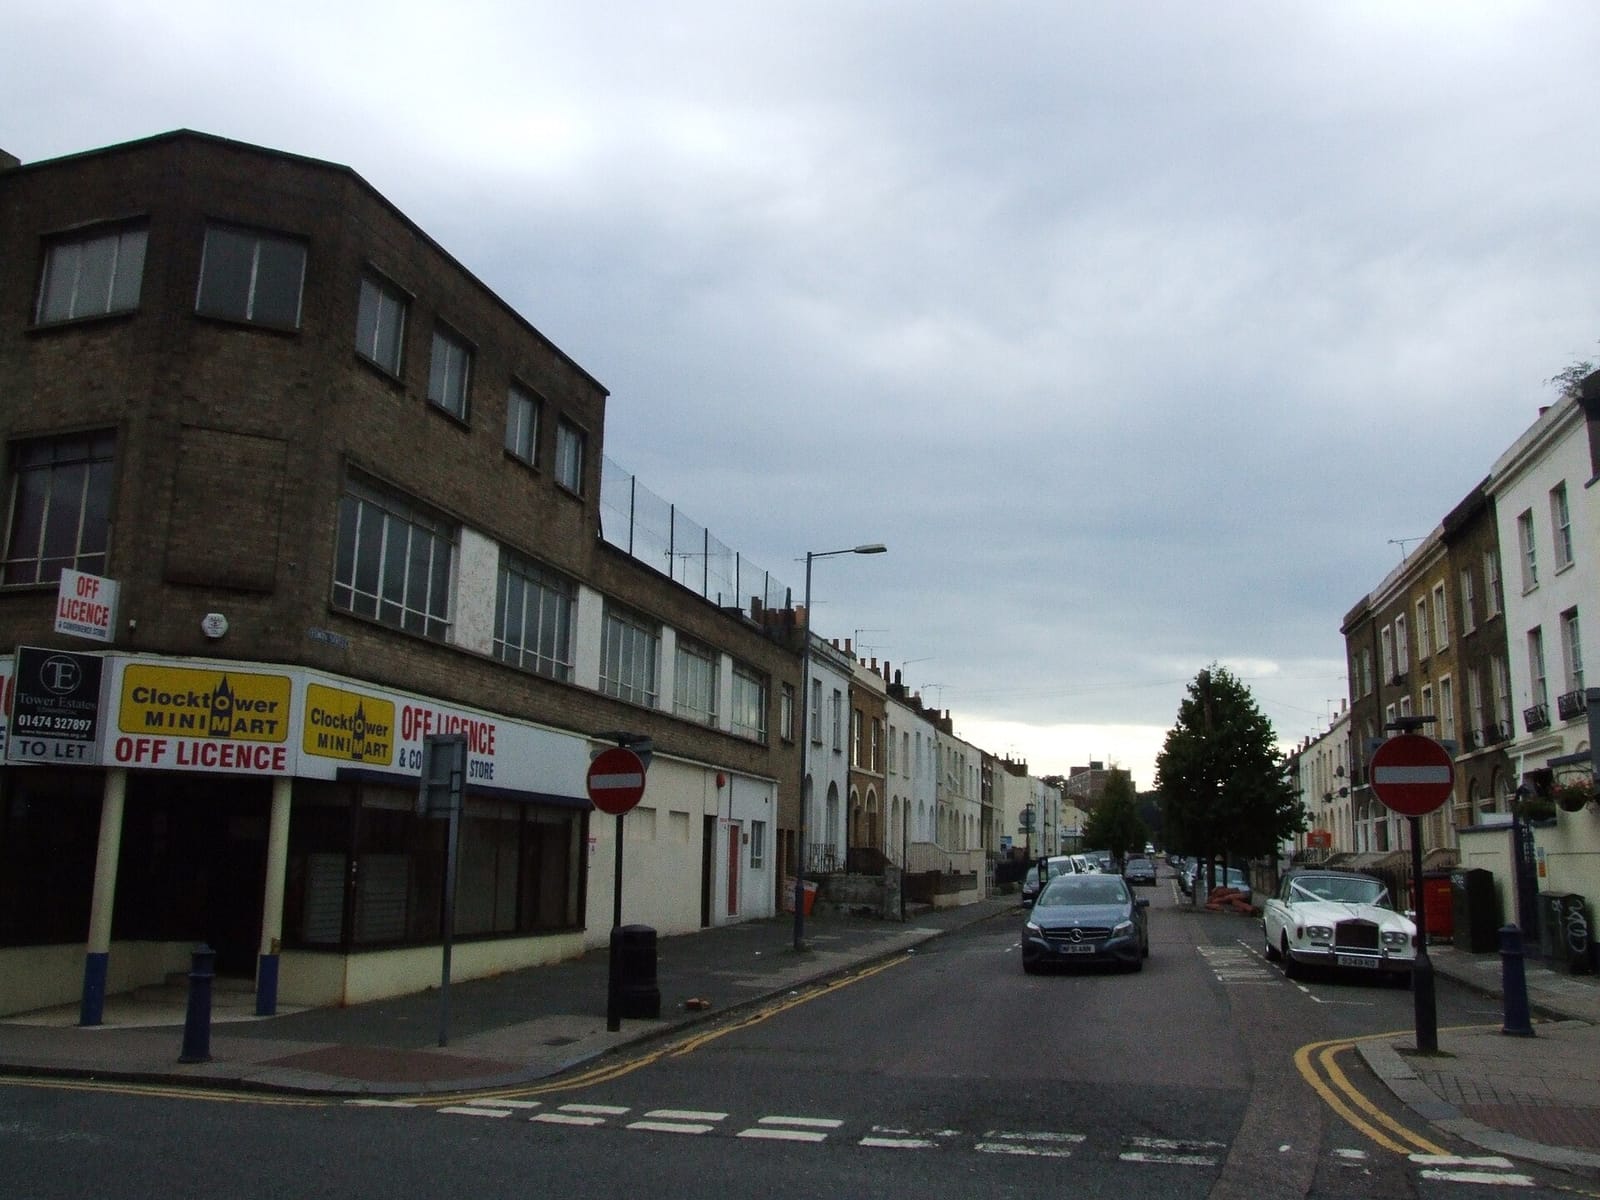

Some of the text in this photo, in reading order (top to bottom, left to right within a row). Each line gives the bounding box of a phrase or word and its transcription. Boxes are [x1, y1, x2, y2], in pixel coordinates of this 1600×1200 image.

[77, 576, 100, 599] OFF
[59, 597, 109, 626] LICENCE
[18, 692, 97, 710] Tower Estates
[132, 686, 279, 713] Clocktower
[18, 714, 92, 732] 01474 327897
[310, 706, 388, 738] Clocktower
[402, 705, 495, 755] OFF LICENCE
[20, 741, 87, 758] TO LET
[115, 737, 287, 770] OFF LICENCE
[399, 748, 406, 767] &
[470, 759, 494, 779] STORE
